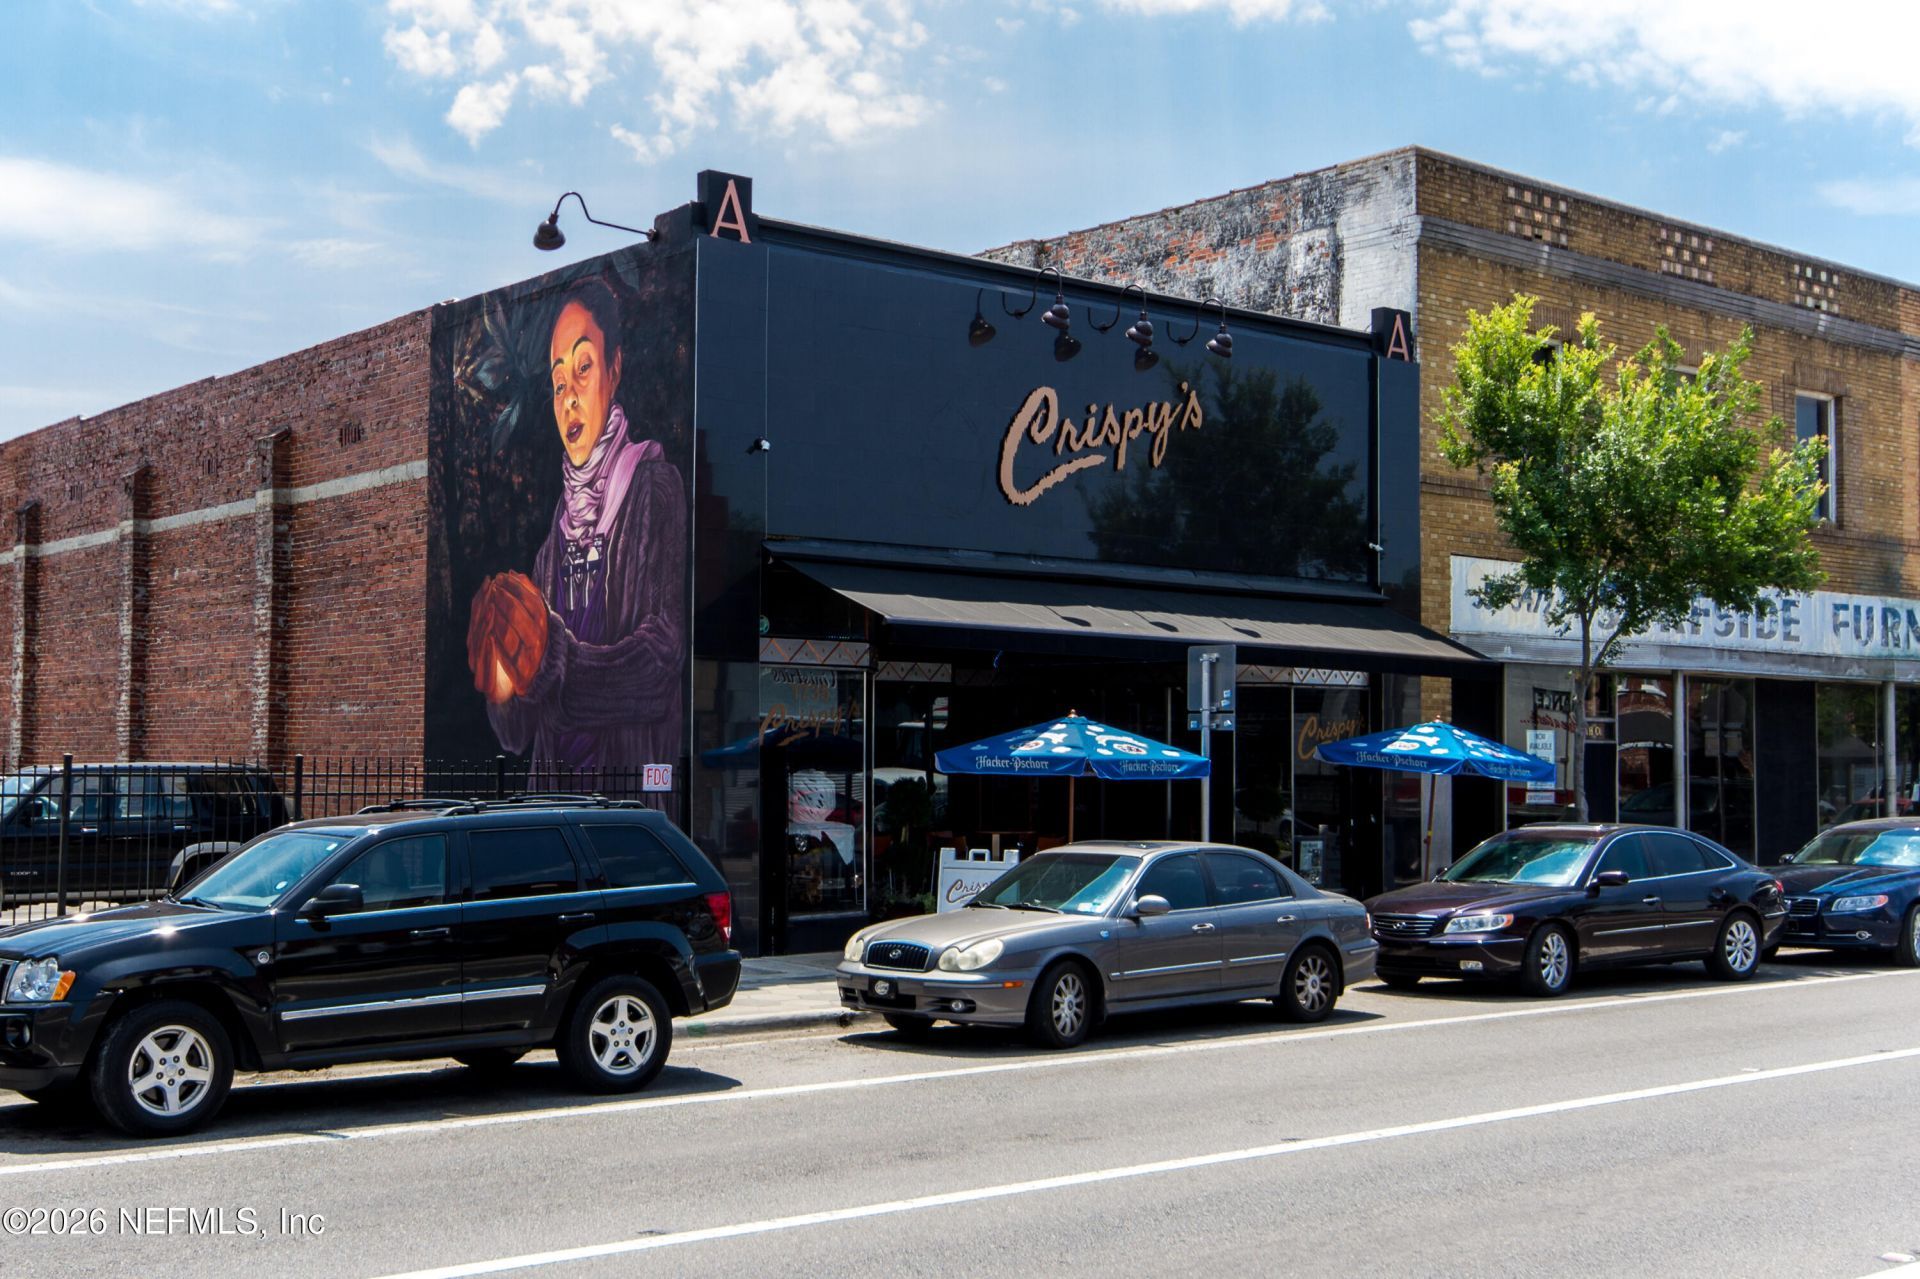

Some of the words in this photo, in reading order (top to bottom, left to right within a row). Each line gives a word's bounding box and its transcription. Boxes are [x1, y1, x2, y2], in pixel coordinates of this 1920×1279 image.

[709, 178, 752, 244] A
[1386, 313, 1410, 362] A
[1000, 381, 1203, 506] Crispy's
[975, 755, 1049, 772] Hacker-Pschorr
[1120, 759, 1180, 775] Hacker-Pschorr
[1356, 751, 1428, 769] Hacker-Pschorr
[646, 768, 669, 786] FDC
